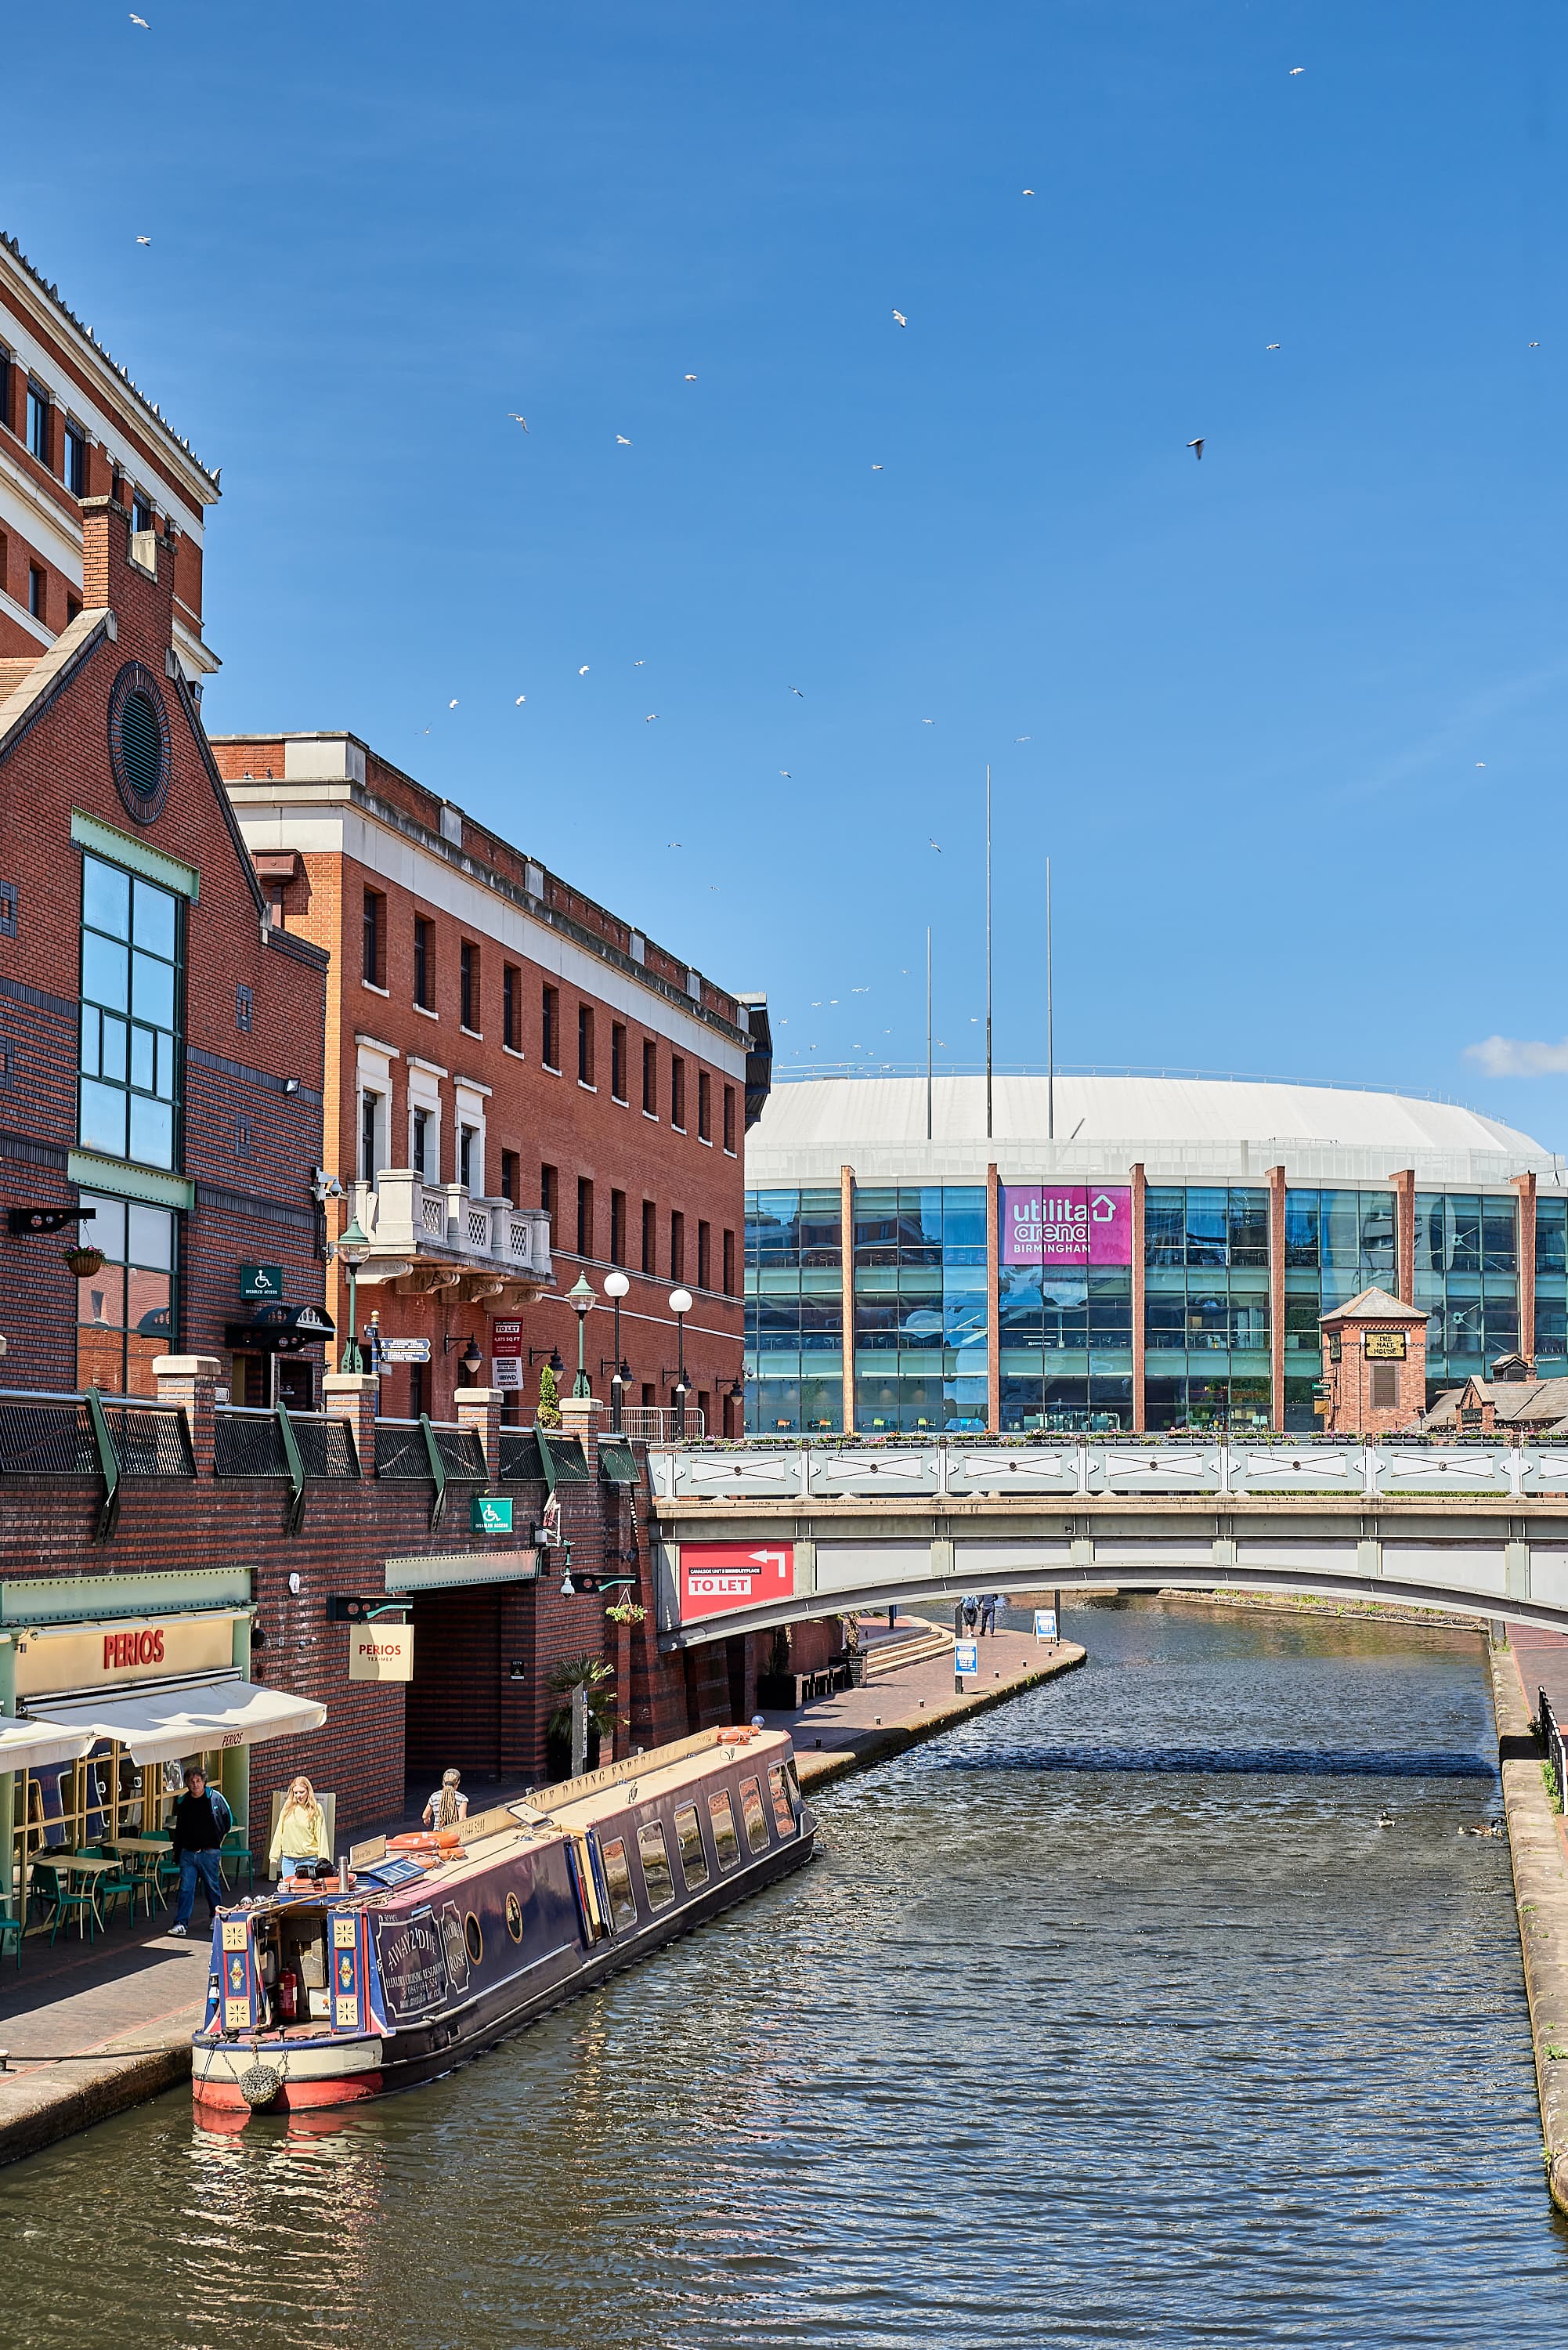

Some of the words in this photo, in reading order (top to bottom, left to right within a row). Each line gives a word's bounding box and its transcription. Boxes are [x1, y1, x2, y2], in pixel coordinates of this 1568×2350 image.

[1013, 1198, 1090, 1222] utilita
[1013, 1224, 1090, 1242] arena
[1013, 1244, 1091, 1253] BIRMINGHAM
[691, 1579, 714, 1592] TO
[718, 1579, 748, 1592] LET
[103, 1629, 164, 1669] PERIOS
[359, 1644, 402, 1655] PERIOS
[222, 1732, 244, 1748] PERIOS
[562, 1770, 605, 1797] DINING
[443, 1922, 462, 1942] MOIRA
[449, 1950, 466, 1972] ROSE
[385, 1974, 406, 1989] LUXURY
[405, 1970, 423, 1985] CRUISING
